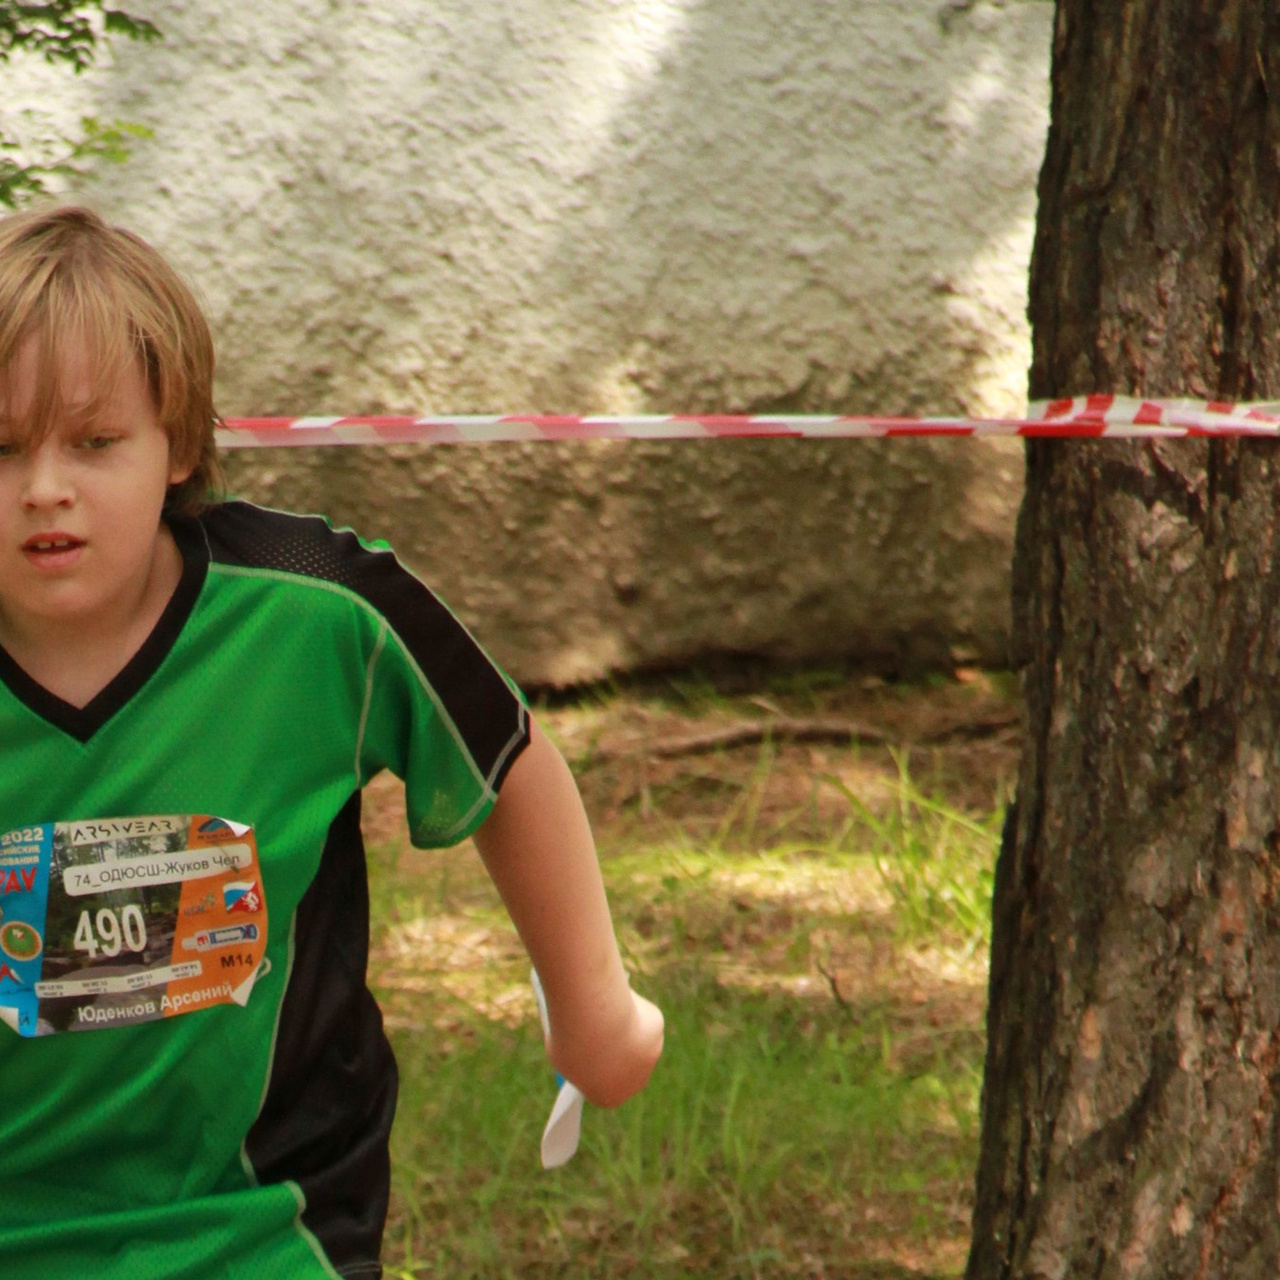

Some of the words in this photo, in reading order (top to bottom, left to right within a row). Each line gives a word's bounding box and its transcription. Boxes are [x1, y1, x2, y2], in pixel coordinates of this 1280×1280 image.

[1, 826, 45, 846] 2022
[73, 859, 210, 889] 74_ОДЮСШ-Жуков
[73, 904, 148, 959] 490
[77, 1000, 156, 1023] Юденков
[159, 983, 235, 1012] Арсений
